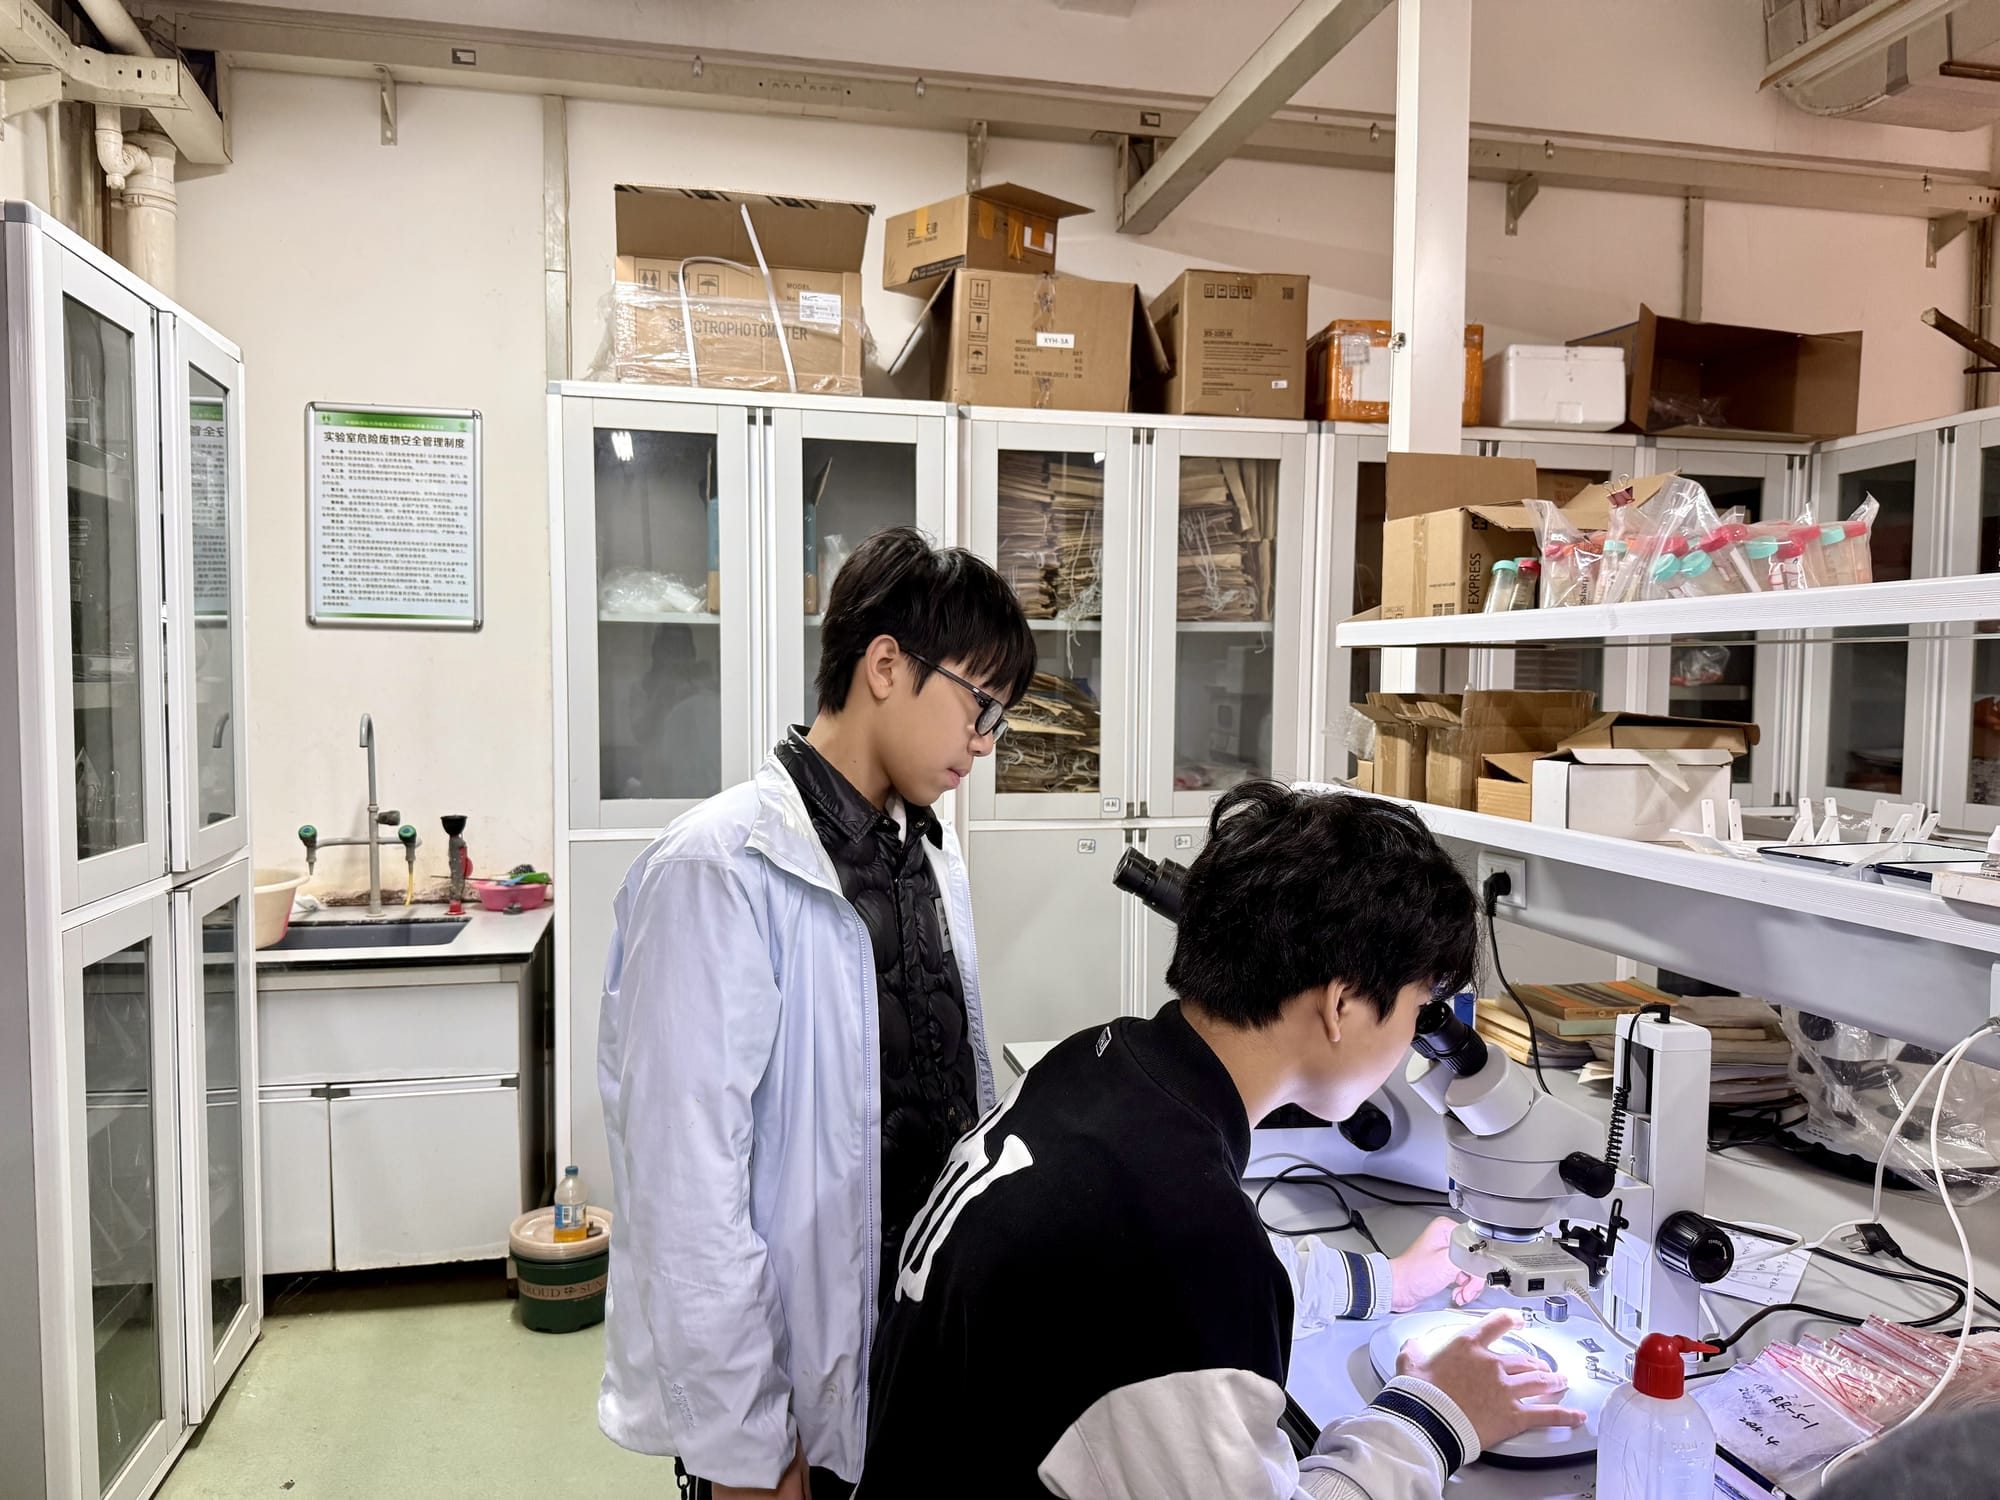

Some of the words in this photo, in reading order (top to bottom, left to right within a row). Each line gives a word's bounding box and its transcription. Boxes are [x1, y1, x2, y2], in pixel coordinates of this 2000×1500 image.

[669, 319, 808, 341] SPCTROPHOTOMTER
[323, 431, 465, 448] 实验室危险废物安全管理制度
[1467, 552, 1482, 605] EXPRESS
